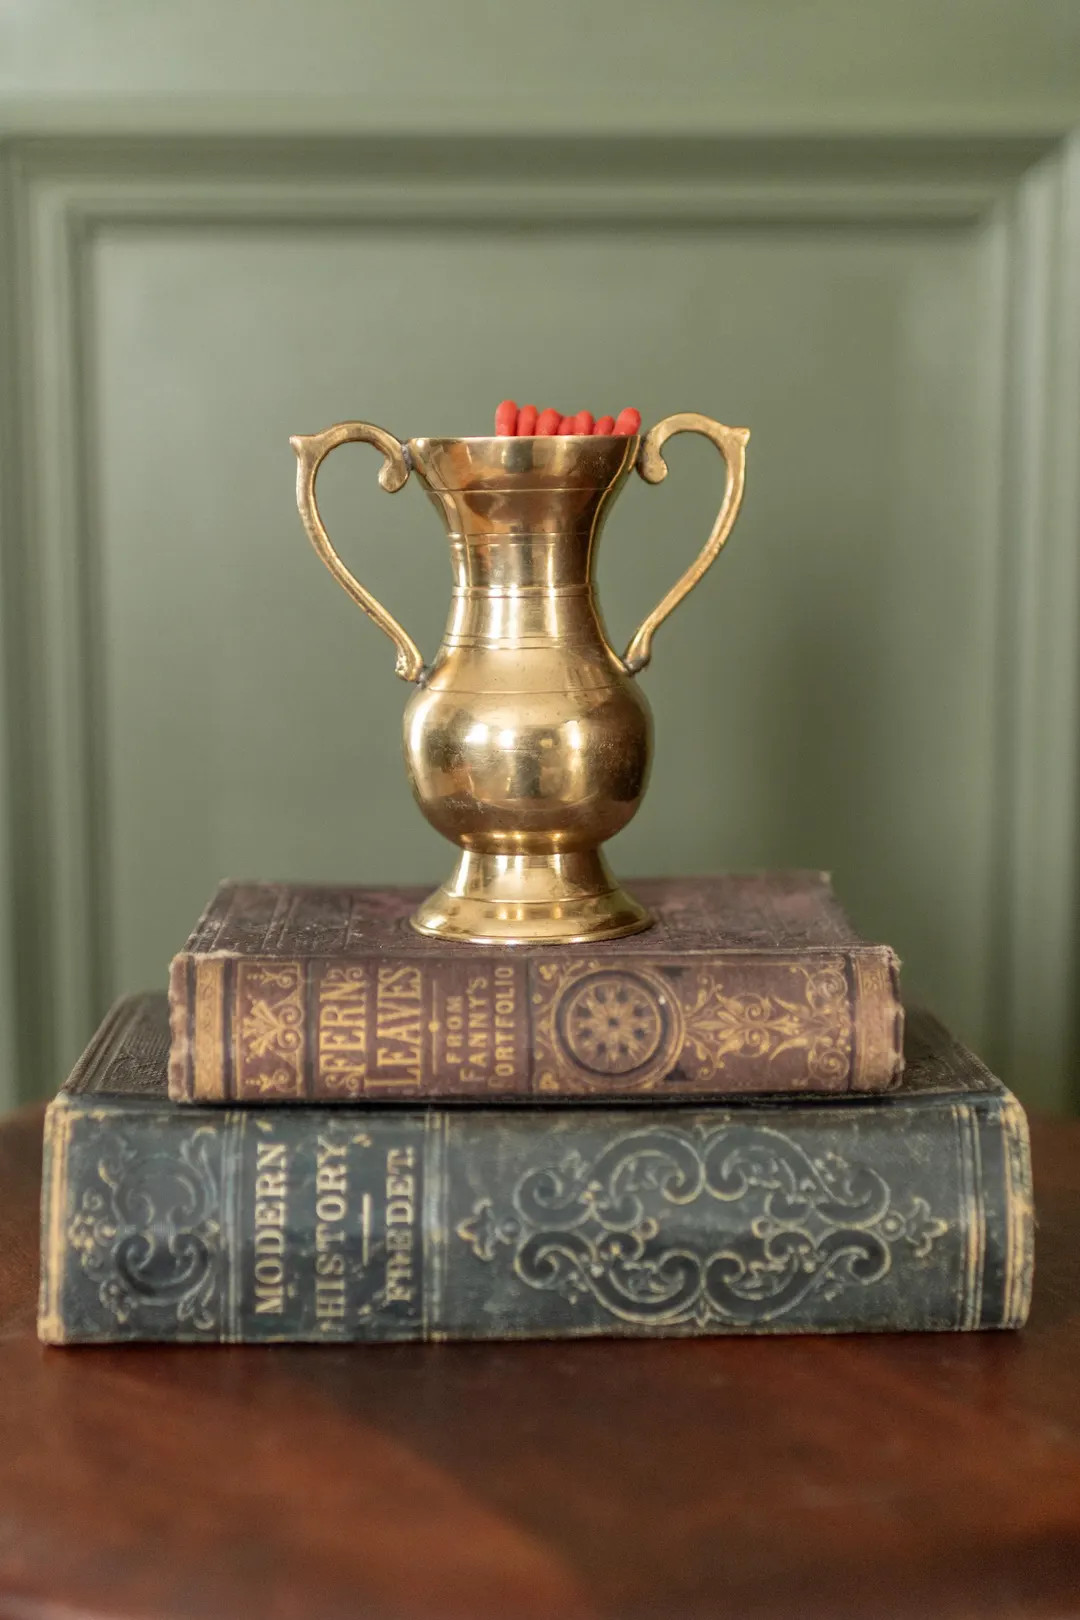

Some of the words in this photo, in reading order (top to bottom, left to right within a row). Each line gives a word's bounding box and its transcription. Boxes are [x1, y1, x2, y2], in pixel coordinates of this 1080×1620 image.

[319, 979, 368, 1076] FERN
[364, 966, 422, 1088] LEAVES
[446, 996, 464, 1064] FROM
[459, 976, 489, 1082] FANNY'S
[488, 967, 515, 1089] PORTFOLIO
[255, 1142, 287, 1314] MODERN
[315, 1135, 347, 1318] HISTORY
